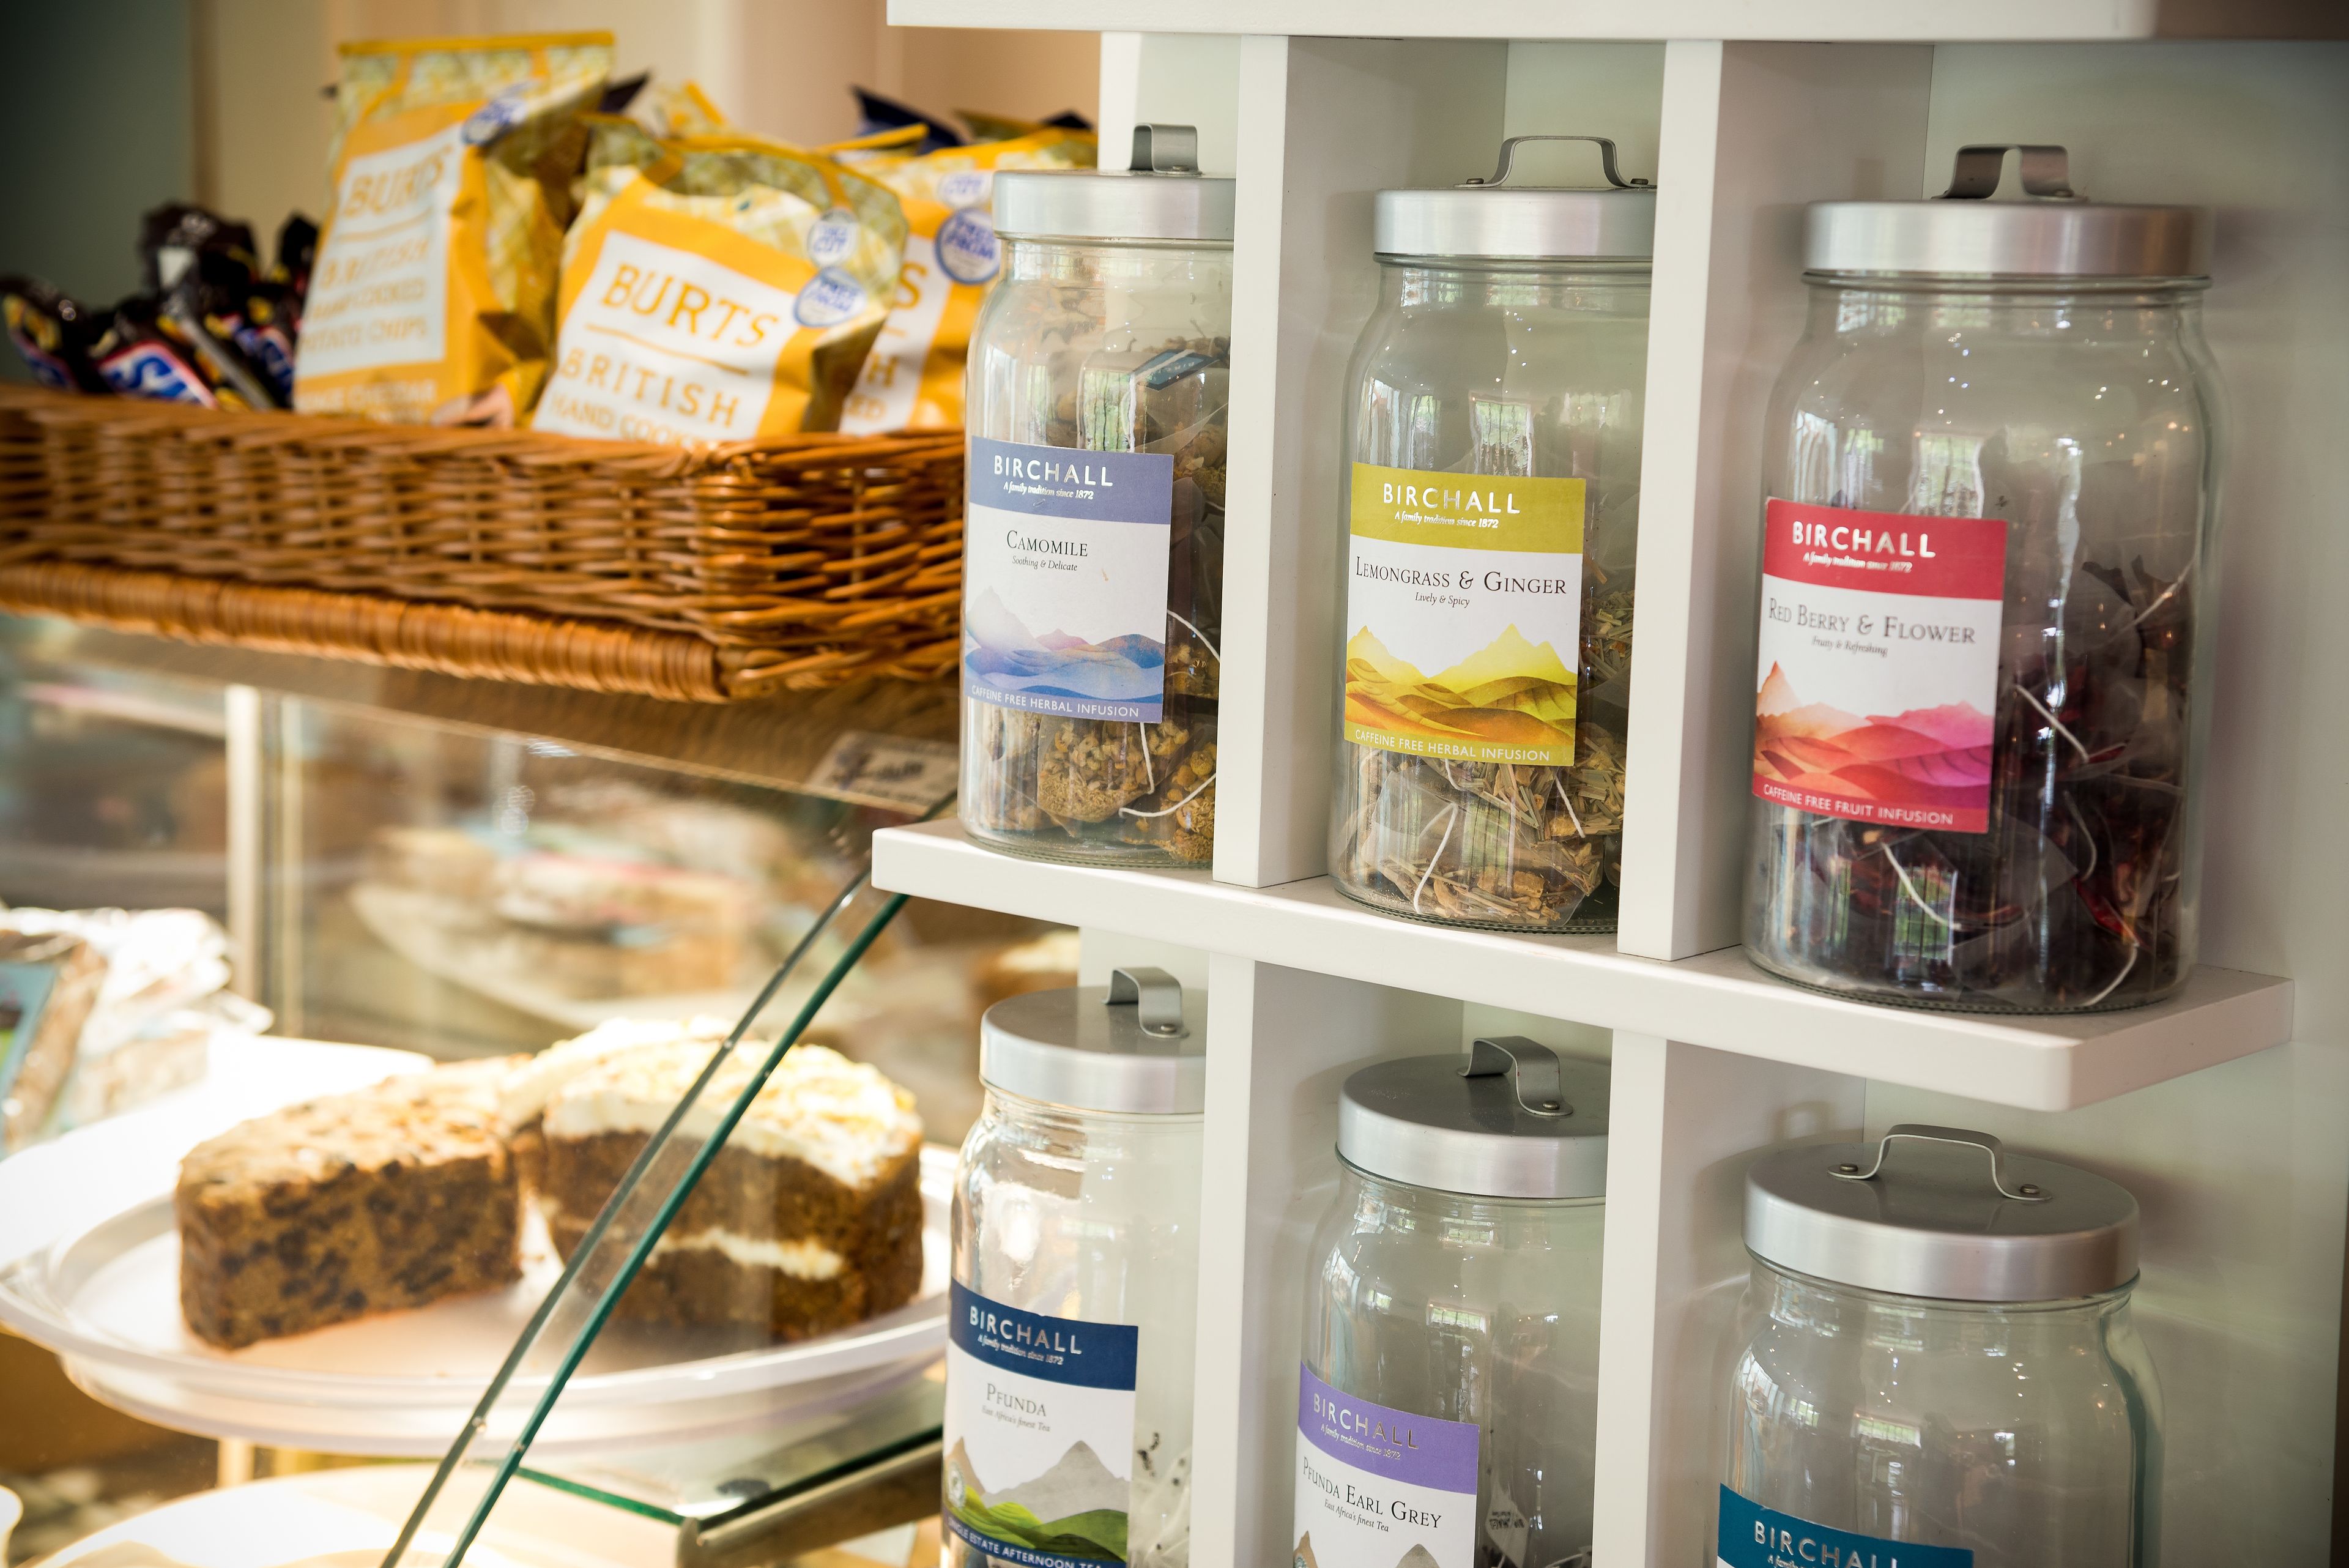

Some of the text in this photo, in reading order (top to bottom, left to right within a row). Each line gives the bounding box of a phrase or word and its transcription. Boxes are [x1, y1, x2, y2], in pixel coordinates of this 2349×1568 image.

[601, 264, 779, 347] BURTS
[561, 347, 739, 428] BRITISH
[994, 455, 1113, 487] BIRCHALL
[1003, 481, 1094, 500] A family tradition since 1872
[1383, 482, 1521, 515] BIRCHALL
[1394, 511, 1499, 529] A family tradition since 1872
[1006, 530, 1088, 557] CAMOMILE
[1792, 521, 1937, 559] BIRCHALL
[1012, 555, 1078, 571] Soothing & Delicate
[1356, 555, 1567, 595] LEMONGRASS & GINGER
[1415, 592, 1471, 609] Lively & Spicy
[1768, 598, 1977, 644] RED BERRY & FLOWER
[1812, 635, 1888, 658] Fruity & Refreshing
[971, 685, 1140, 718] CAFFEINE FREE HERBAL INFUSION
[1355, 729, 1551, 762] CAFFEINE FREE HERBAL INFUSION
[1763, 784, 1954, 826] CAFFEINE FREE FRUIT INFUSION
[969, 1305, 1082, 1355] BIRCHALL
[987, 1383, 1047, 1417] PFUNDA
[1037, 1421, 1051, 1432] Tea
[1313, 1393, 1419, 1449] BIRCHALL
[1321, 1424, 1401, 1460] A family tradition since 1872
[1302, 1456, 1442, 1529] PFUNDA EARL GREY
[1324, 1499, 1389, 1533] East Africa's finest Tea
[970, 1533, 1000, 1555] ESTATE
[1002, 1546, 1075, 1568] AFTERNOON
